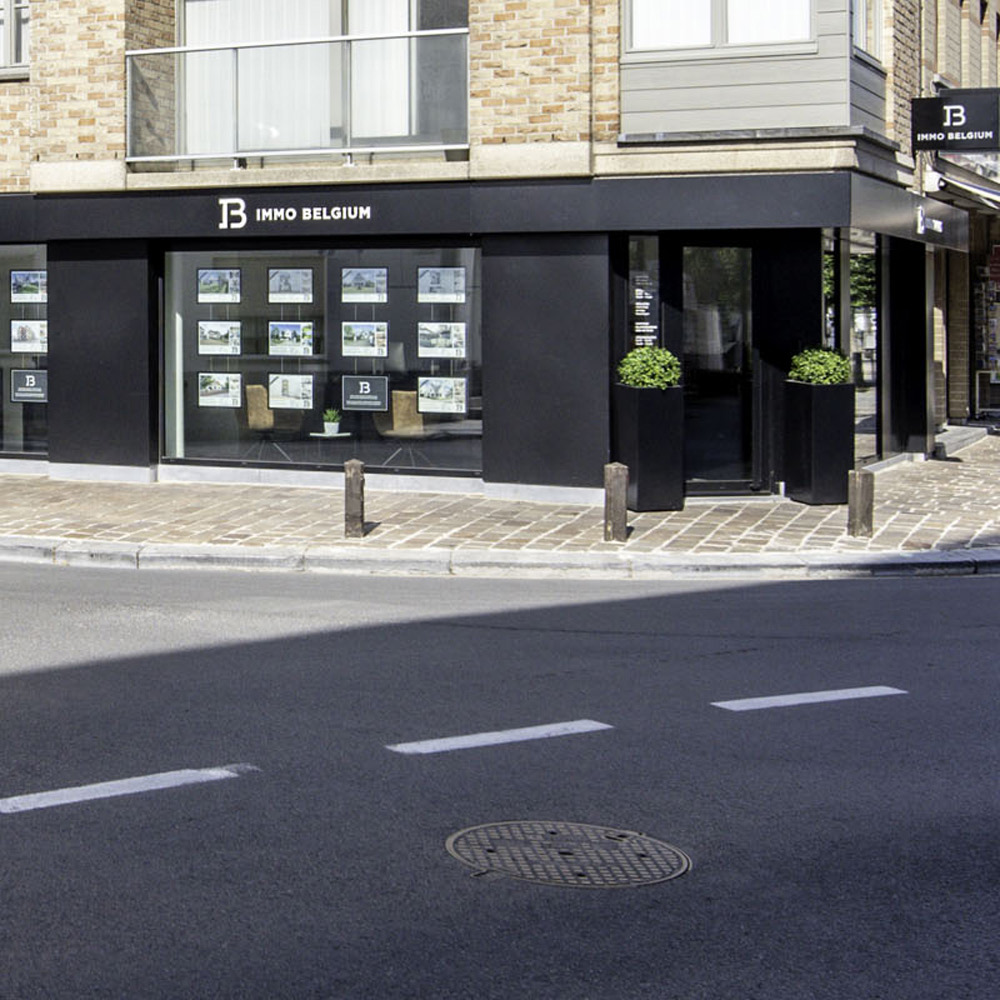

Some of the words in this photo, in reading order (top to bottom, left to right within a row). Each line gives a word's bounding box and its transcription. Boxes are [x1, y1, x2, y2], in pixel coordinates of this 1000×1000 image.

[943, 105, 966, 126] B
[917, 133, 945, 141] IMMO
[948, 131, 993, 140] BELGIUM
[219, 198, 247, 229] B
[256, 208, 297, 221] IMMO
[302, 206, 371, 220] BELGIUM
